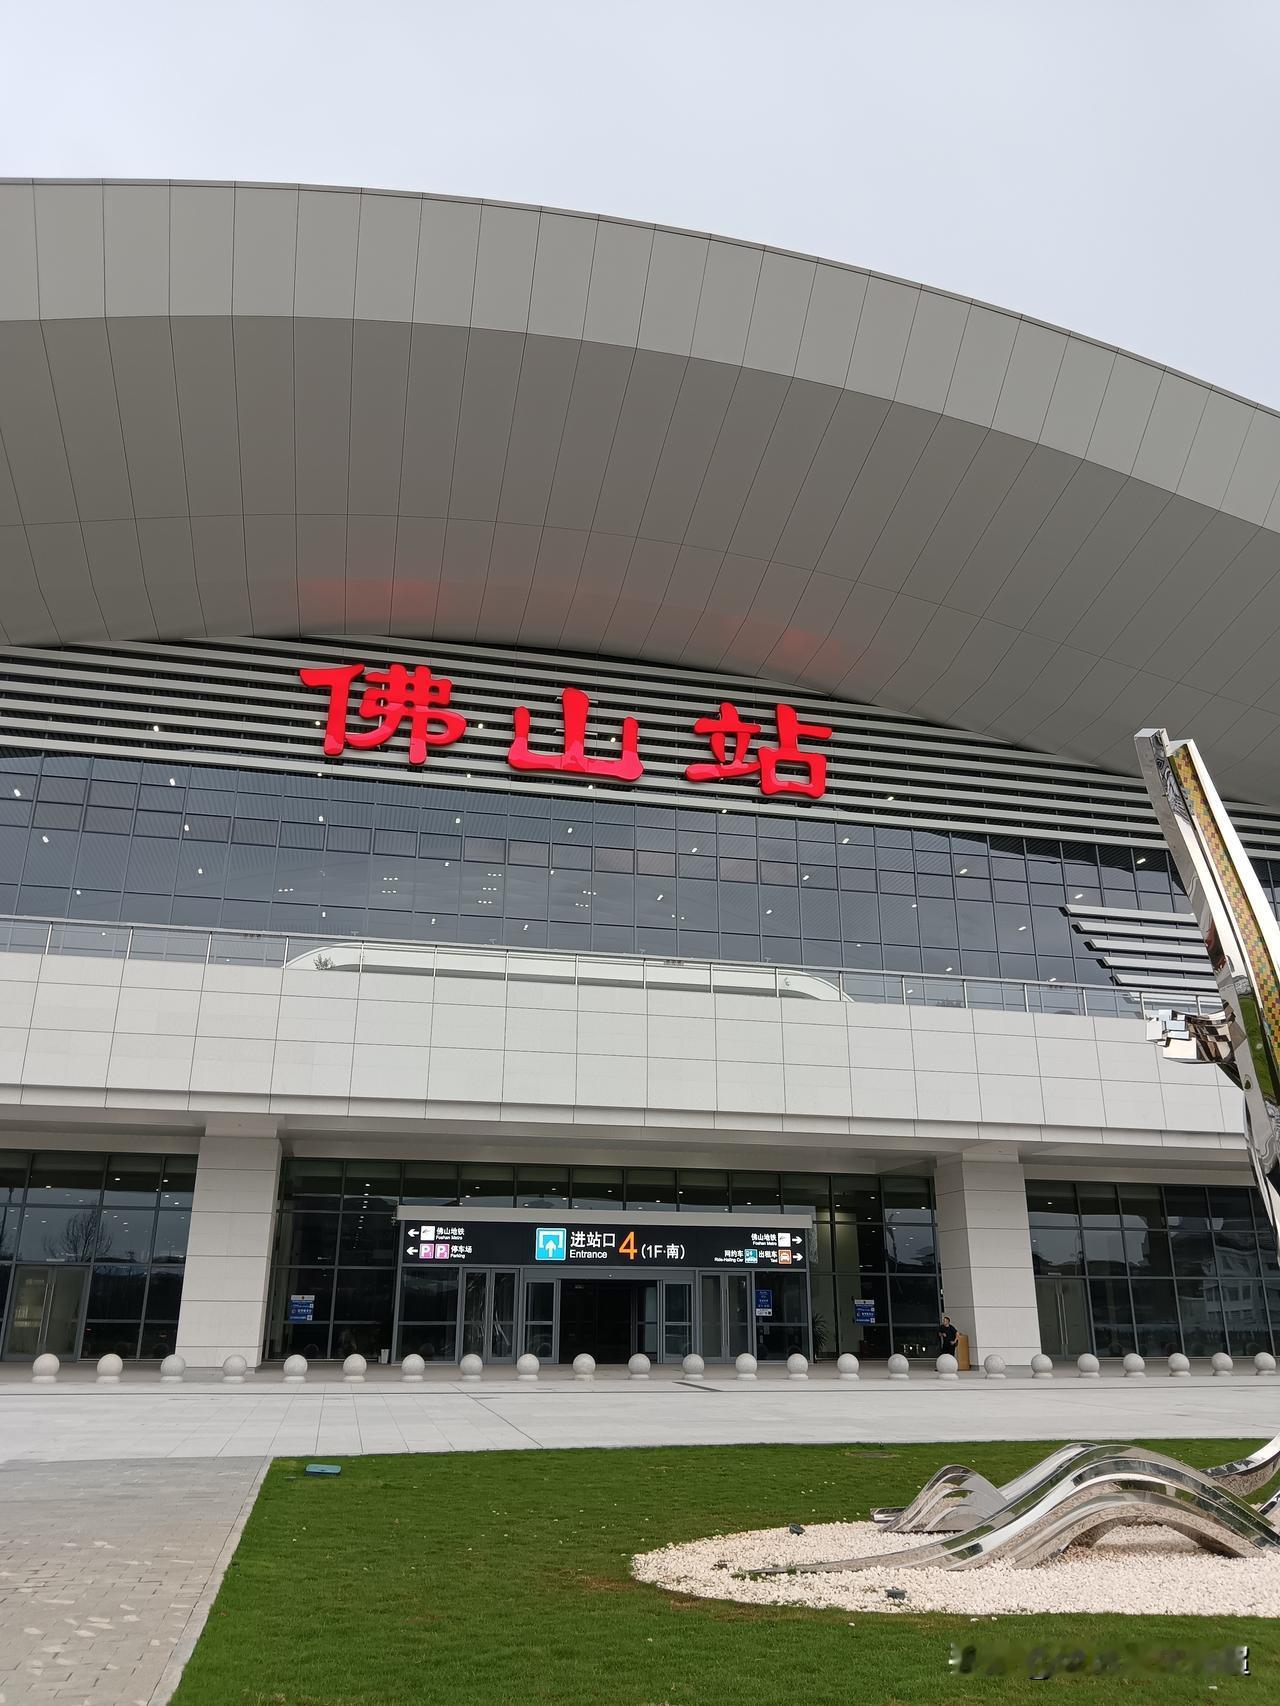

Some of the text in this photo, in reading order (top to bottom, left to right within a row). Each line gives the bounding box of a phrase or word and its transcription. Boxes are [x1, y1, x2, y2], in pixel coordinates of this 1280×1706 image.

[300, 663, 832, 799] 佛山站
[436, 1227, 465, 1235] 佛山地铁
[751, 1233, 777, 1241] 佛山地铁
[451, 1245, 472, 1253] 停车场
[570, 1231, 616, 1248] 进站口
[618, 1231, 638, 1260] 4
[569, 1249, 608, 1259] Entrance
